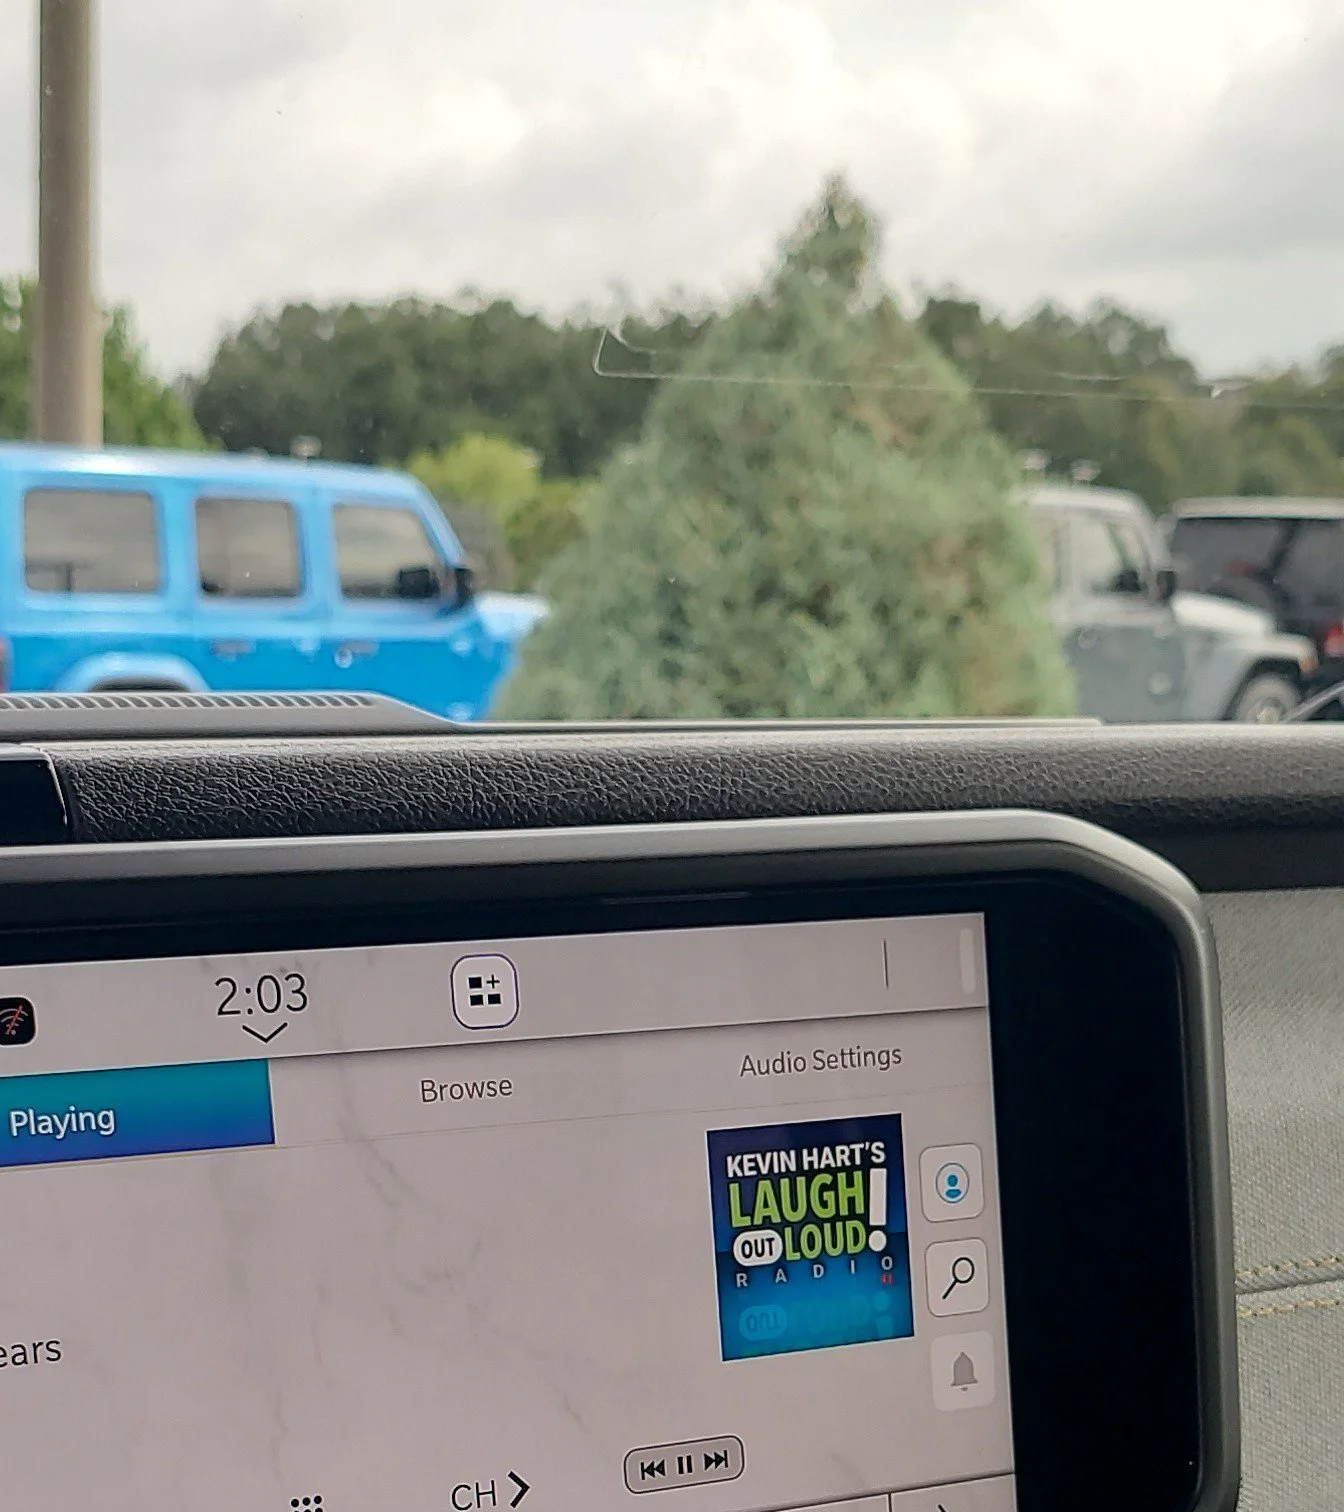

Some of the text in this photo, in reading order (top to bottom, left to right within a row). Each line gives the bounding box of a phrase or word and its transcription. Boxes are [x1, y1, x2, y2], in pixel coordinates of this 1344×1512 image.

[214, 973, 309, 1019] 2:03
[739, 1045, 903, 1078] Audio Settings
[420, 1075, 513, 1104] Browse
[8, 1106, 117, 1142] Playing
[727, 1141, 887, 1178] KEVIN HART'S
[729, 1170, 865, 1228] LAUGH
[741, 1237, 775, 1260] OUT
[451, 1480, 498, 1511] CH
